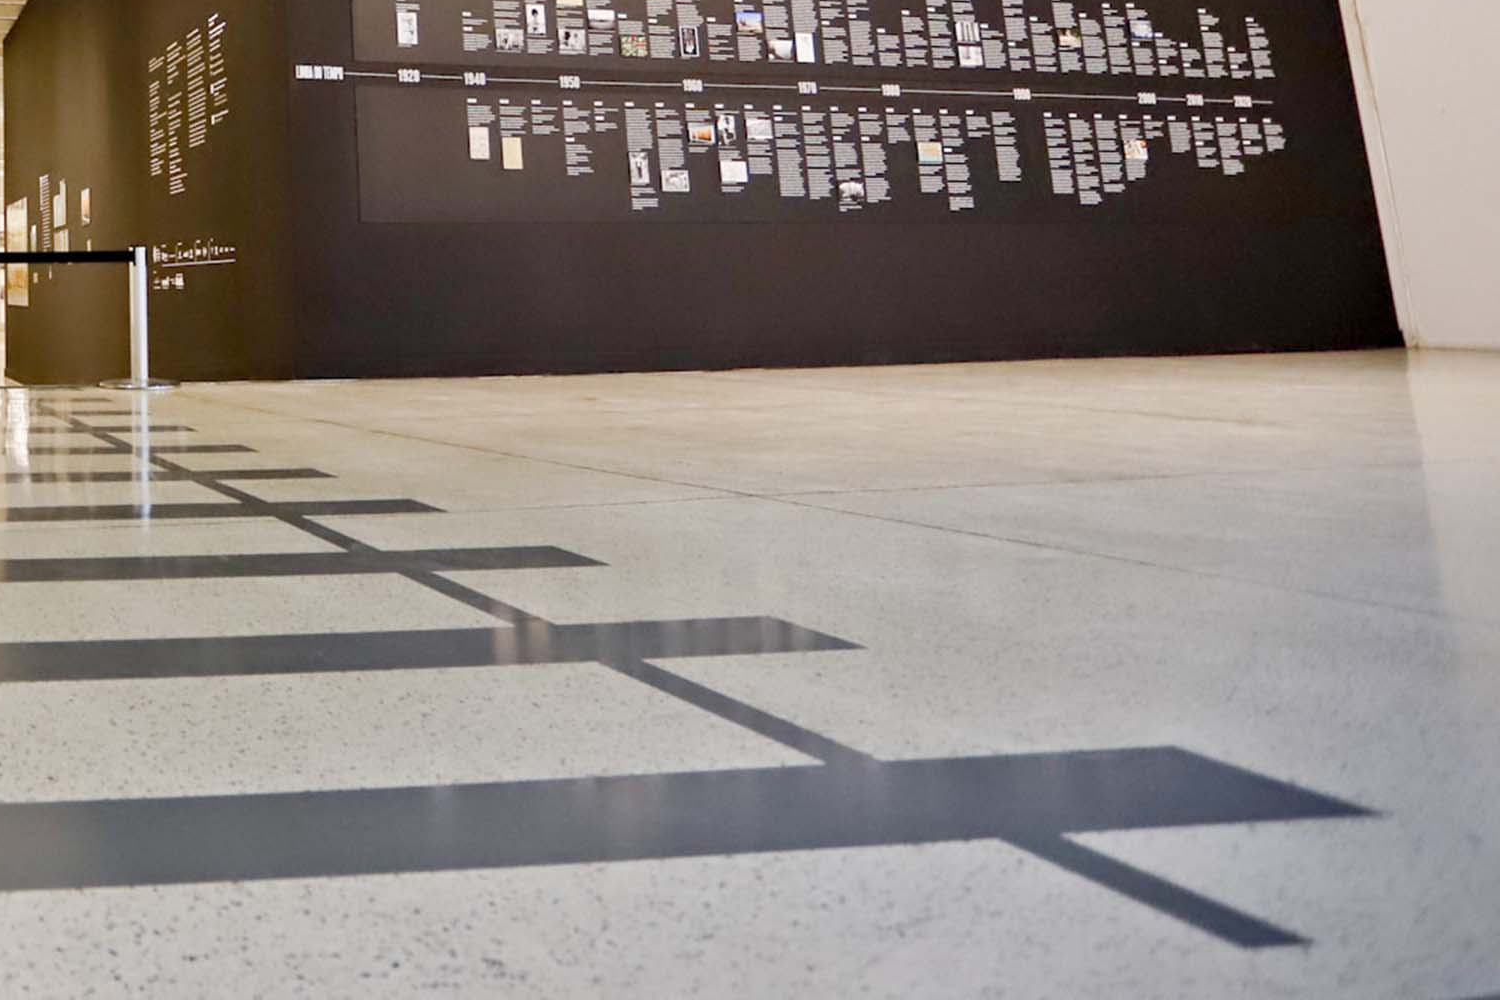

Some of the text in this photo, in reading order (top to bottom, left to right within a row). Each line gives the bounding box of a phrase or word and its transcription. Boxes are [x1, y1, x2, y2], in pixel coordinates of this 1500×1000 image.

[397, 68, 421, 83] 1920
[463, 72, 486, 86] 1940
[558, 75, 580, 89] 1950
